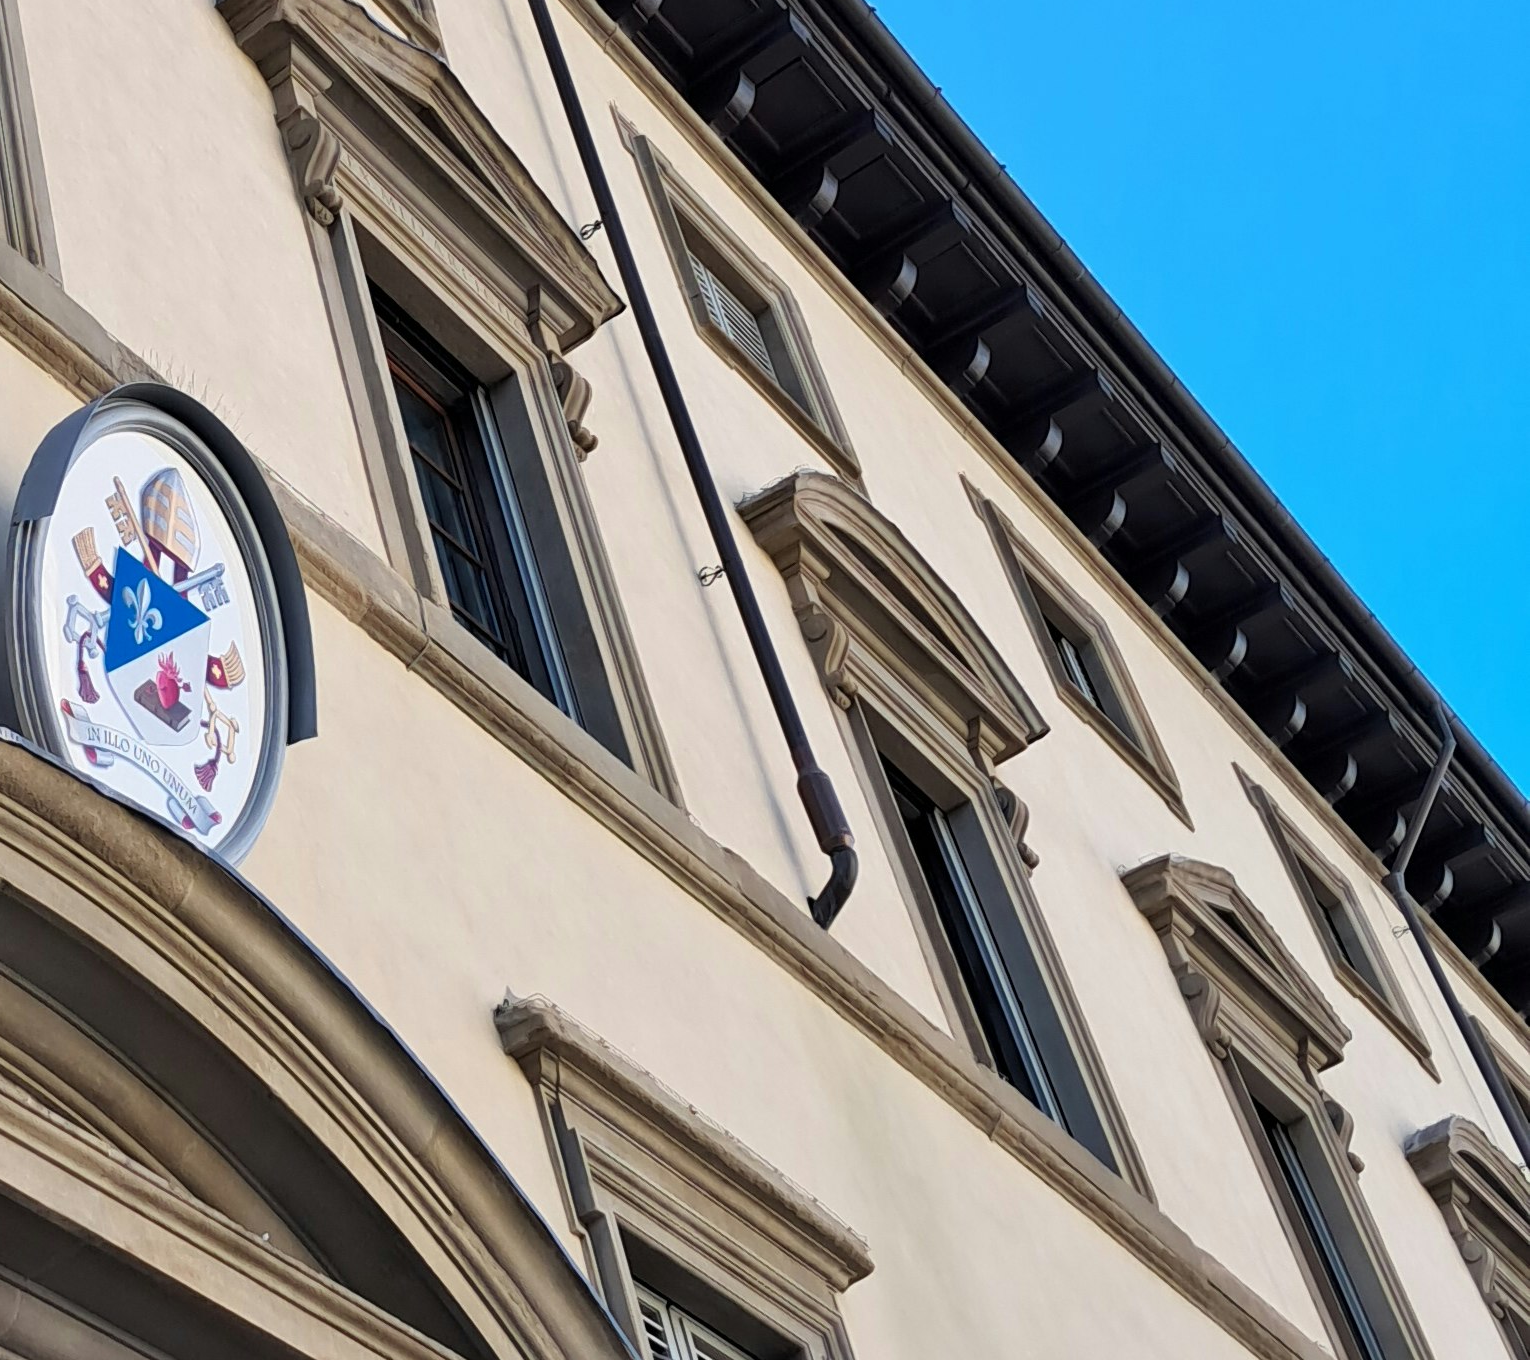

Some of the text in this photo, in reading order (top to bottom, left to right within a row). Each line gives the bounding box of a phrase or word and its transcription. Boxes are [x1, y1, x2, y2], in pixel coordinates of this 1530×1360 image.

[87, 726, 198, 815] IN ILLO UNO UNUM
